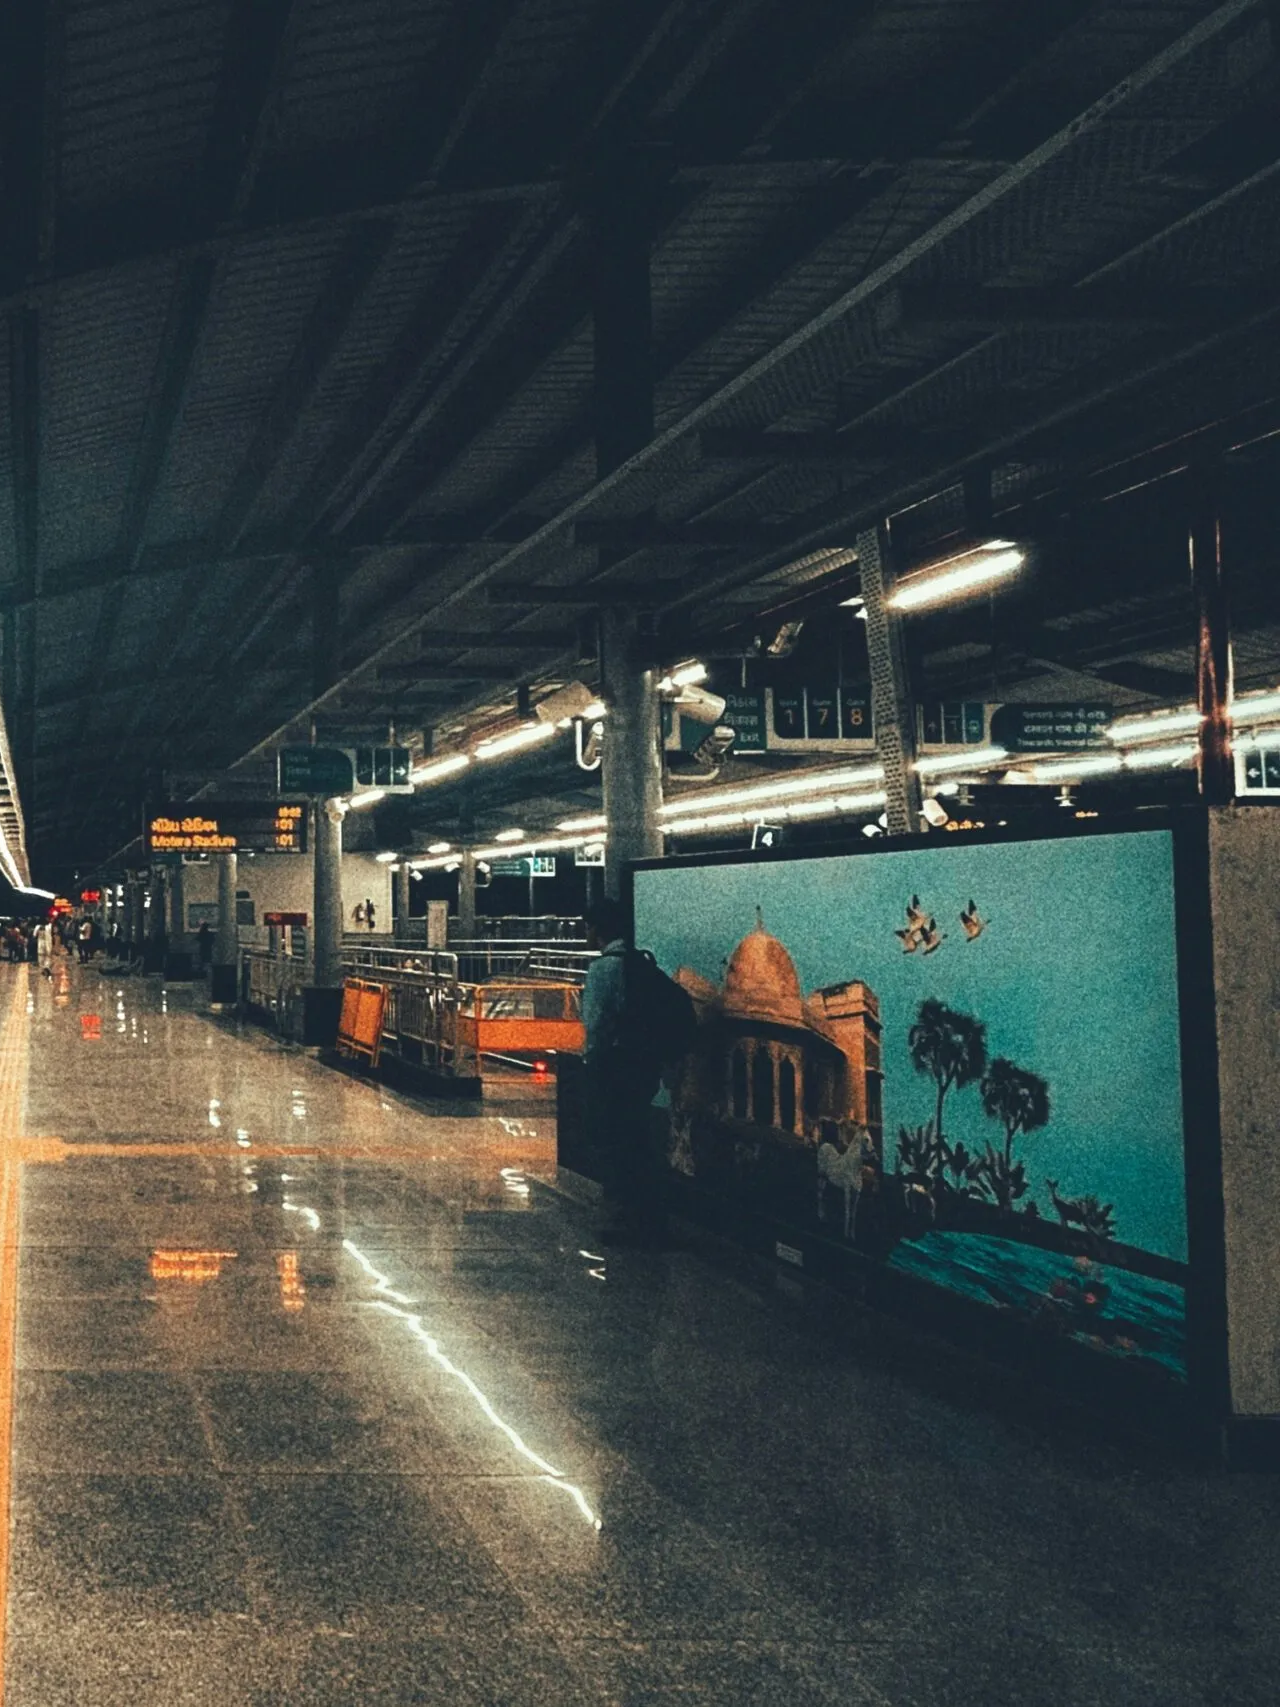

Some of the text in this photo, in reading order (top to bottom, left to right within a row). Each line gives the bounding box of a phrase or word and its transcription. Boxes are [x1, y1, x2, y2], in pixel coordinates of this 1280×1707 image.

[784, 709, 794, 725] 1
[817, 708, 828, 725] 7
[850, 708, 863, 726] 8
[740, 733, 759, 743] Exit
[151, 834, 237, 847] Motera Stadium
